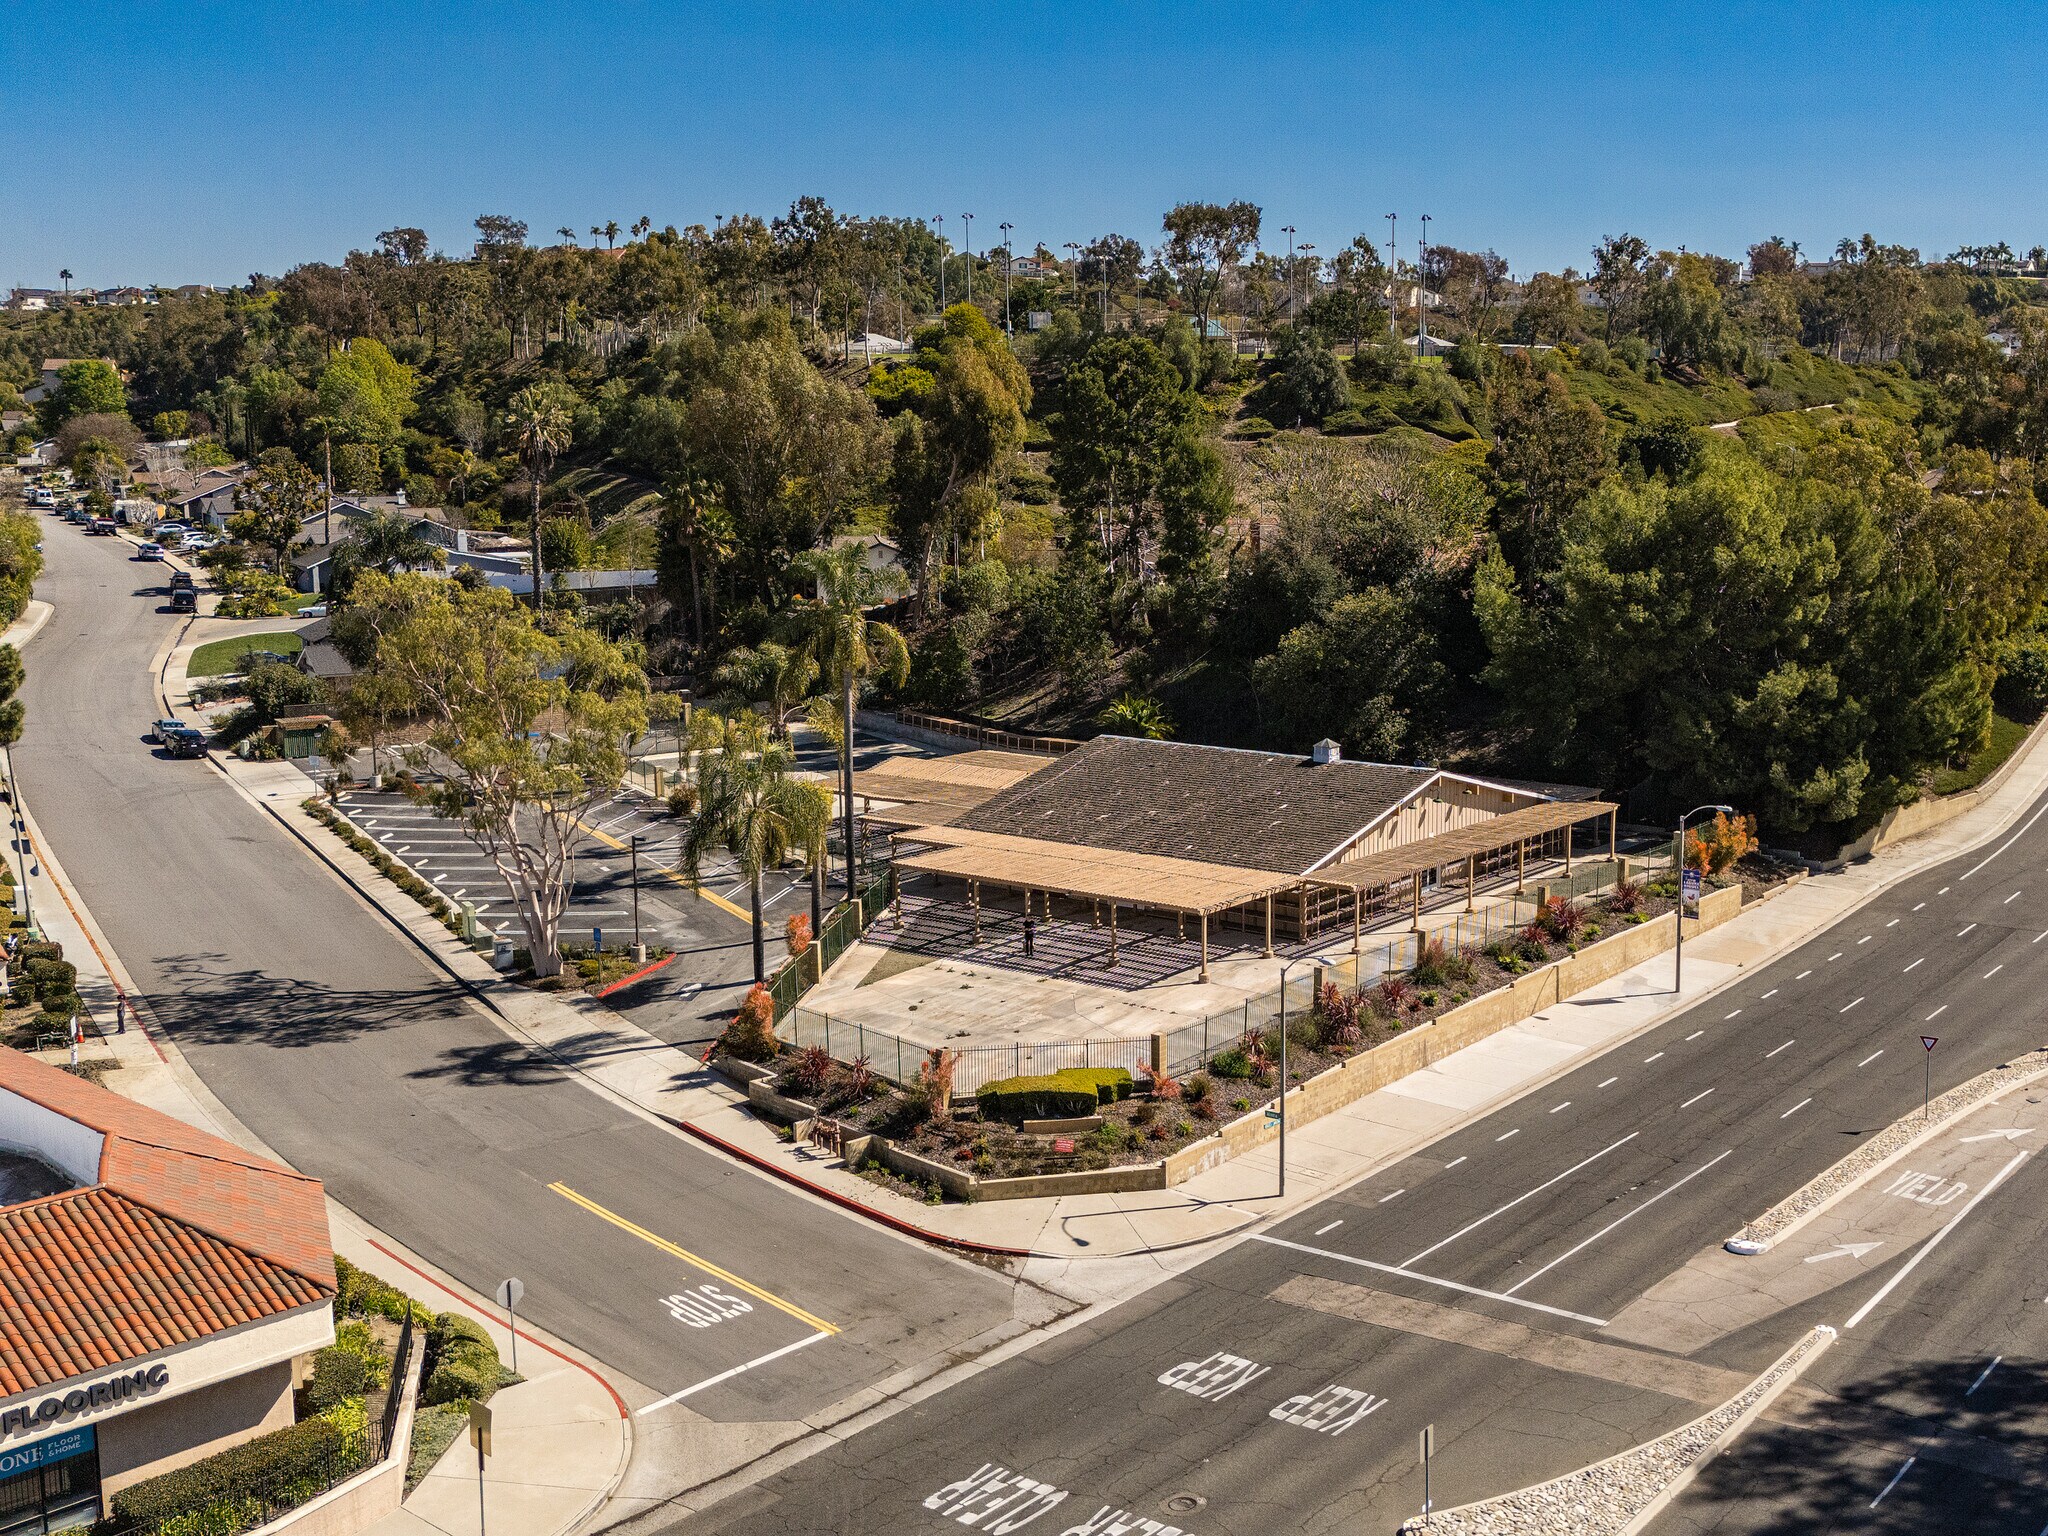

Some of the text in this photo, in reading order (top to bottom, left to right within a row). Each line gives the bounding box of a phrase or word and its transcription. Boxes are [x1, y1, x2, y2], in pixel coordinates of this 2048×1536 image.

[1883, 1170, 1967, 1205] YIELD
[658, 1284, 753, 1328] STOP
[3, 1363, 169, 1435] FLOORING
[1157, 1351, 1271, 1402] KEEP
[1269, 1384, 1389, 1436] KEEP
[48, 1434, 81, 1450] FLOOR
[922, 1463, 1069, 1536] CLEAR
